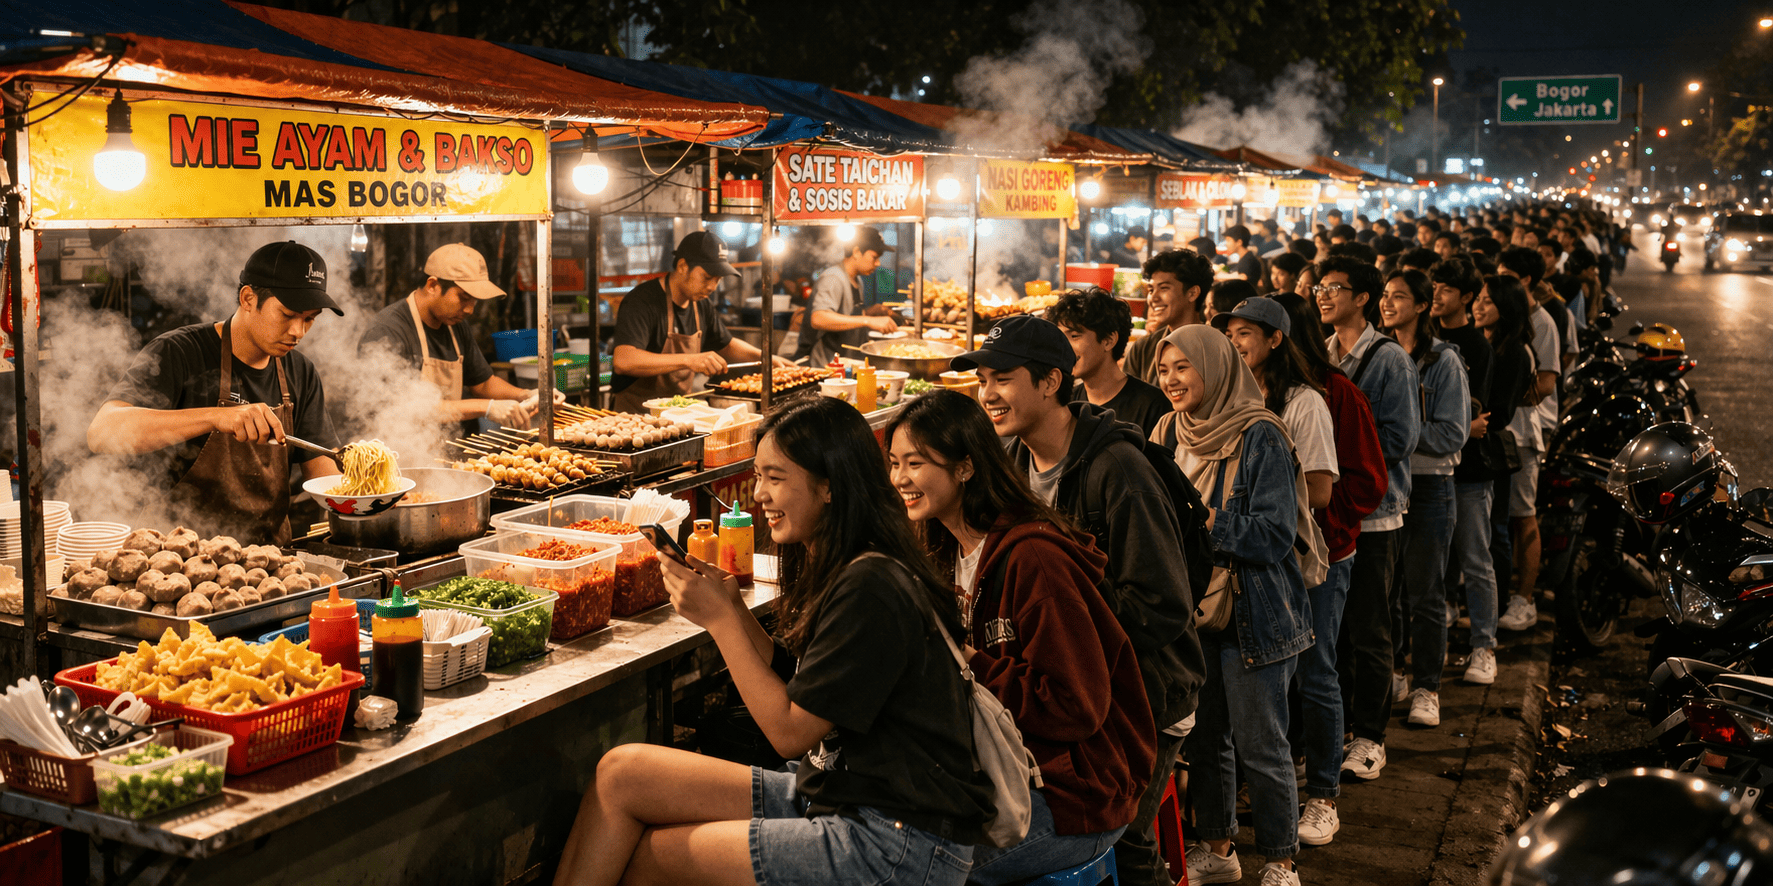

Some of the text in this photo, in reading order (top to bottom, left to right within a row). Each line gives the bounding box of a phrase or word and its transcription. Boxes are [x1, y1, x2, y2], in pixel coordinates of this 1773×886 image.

[1536, 83, 1589, 101] Bogor
[1534, 102, 1597, 117] Jakarta
[168, 114, 533, 176] MIE AYAM & BAKSO
[788, 153, 914, 185] SATE TAICHAN
[988, 166, 1069, 191] NASI GORENG
[264, 180, 447, 208] MAS BOGOR
[788, 187, 907, 212] & SOSIS BAKAR
[1160, 180, 1198, 200] SEBLAK
[1005, 194, 1057, 212] KAMBING
